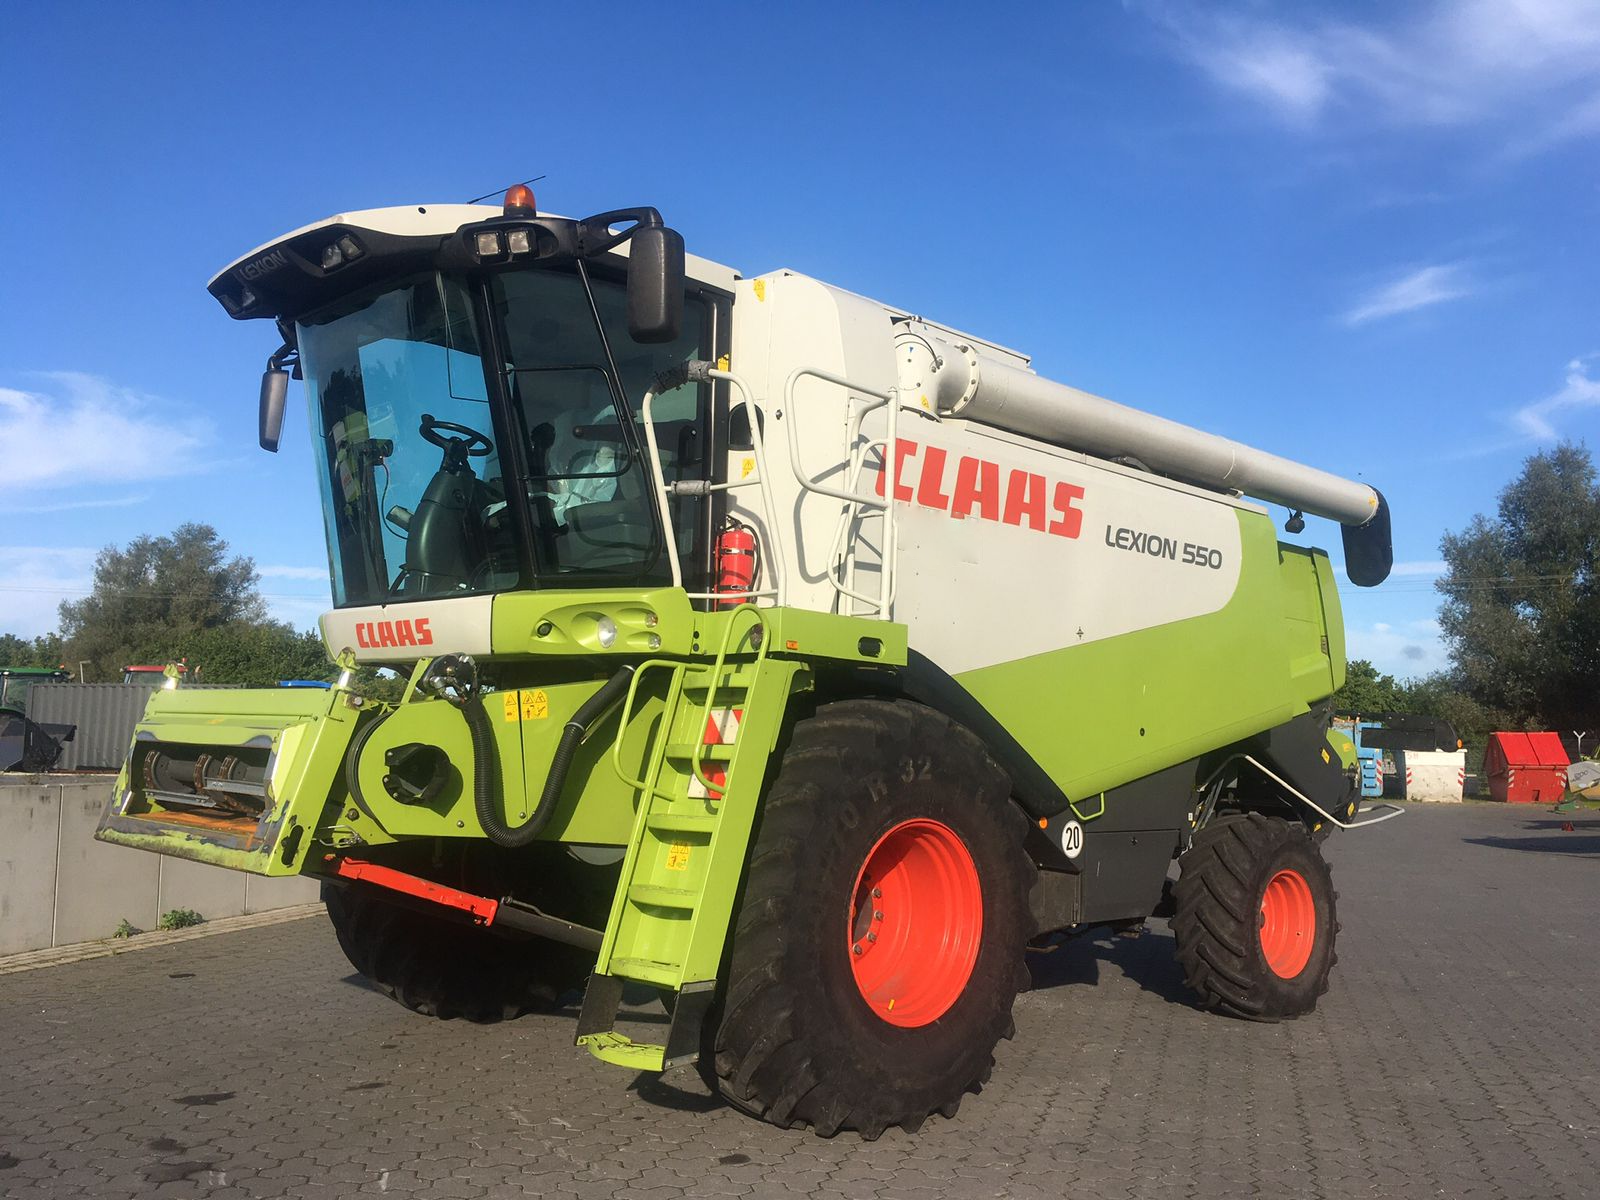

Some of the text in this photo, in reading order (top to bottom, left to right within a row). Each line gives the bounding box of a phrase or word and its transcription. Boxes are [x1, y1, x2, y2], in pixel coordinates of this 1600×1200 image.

[239, 250, 288, 281] LEXION
[874, 437, 1086, 540] CLAAS
[1105, 524, 1223, 570] LEXION 550
[355, 617, 434, 649] CLAAS
[1065, 825, 1080, 851] 20
